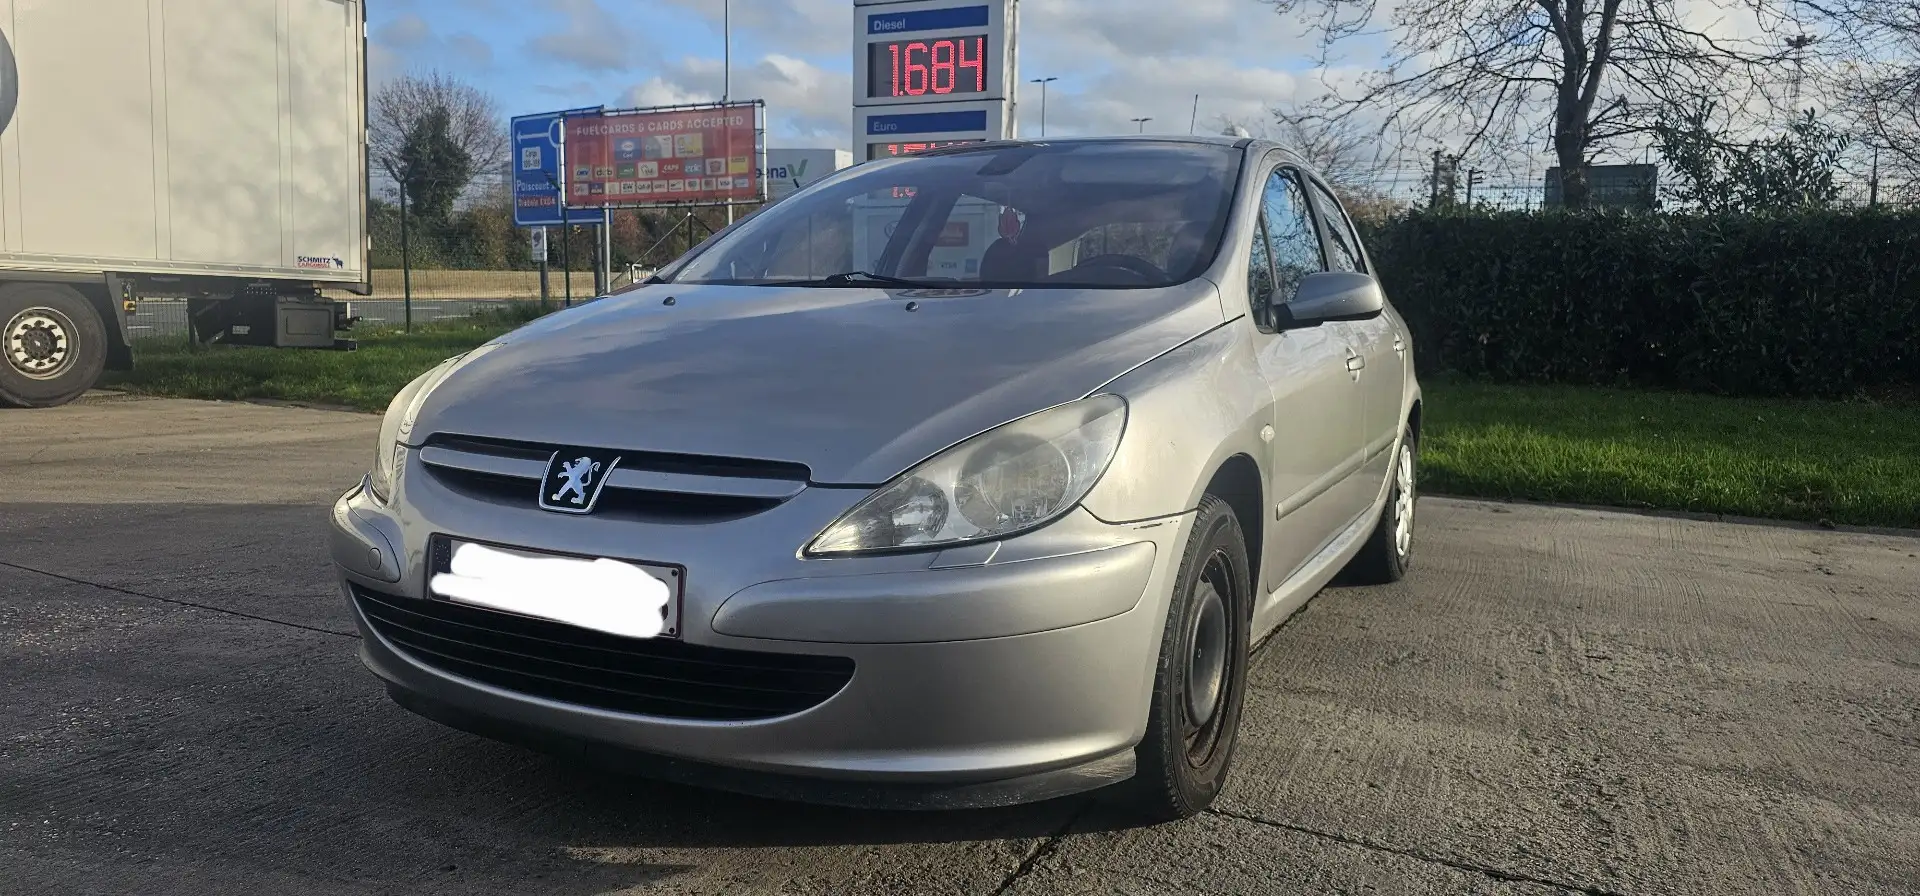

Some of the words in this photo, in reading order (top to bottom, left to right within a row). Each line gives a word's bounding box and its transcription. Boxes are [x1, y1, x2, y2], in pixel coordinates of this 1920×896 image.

[873, 18, 906, 31] Diesel
[889, 37, 983, 97] 1.684
[649, 120, 683, 132] CARDS
[687, 115, 744, 128] ACCEPTED
[873, 121, 898, 131] Euro
[297, 255, 331, 264] SCHMITZ
